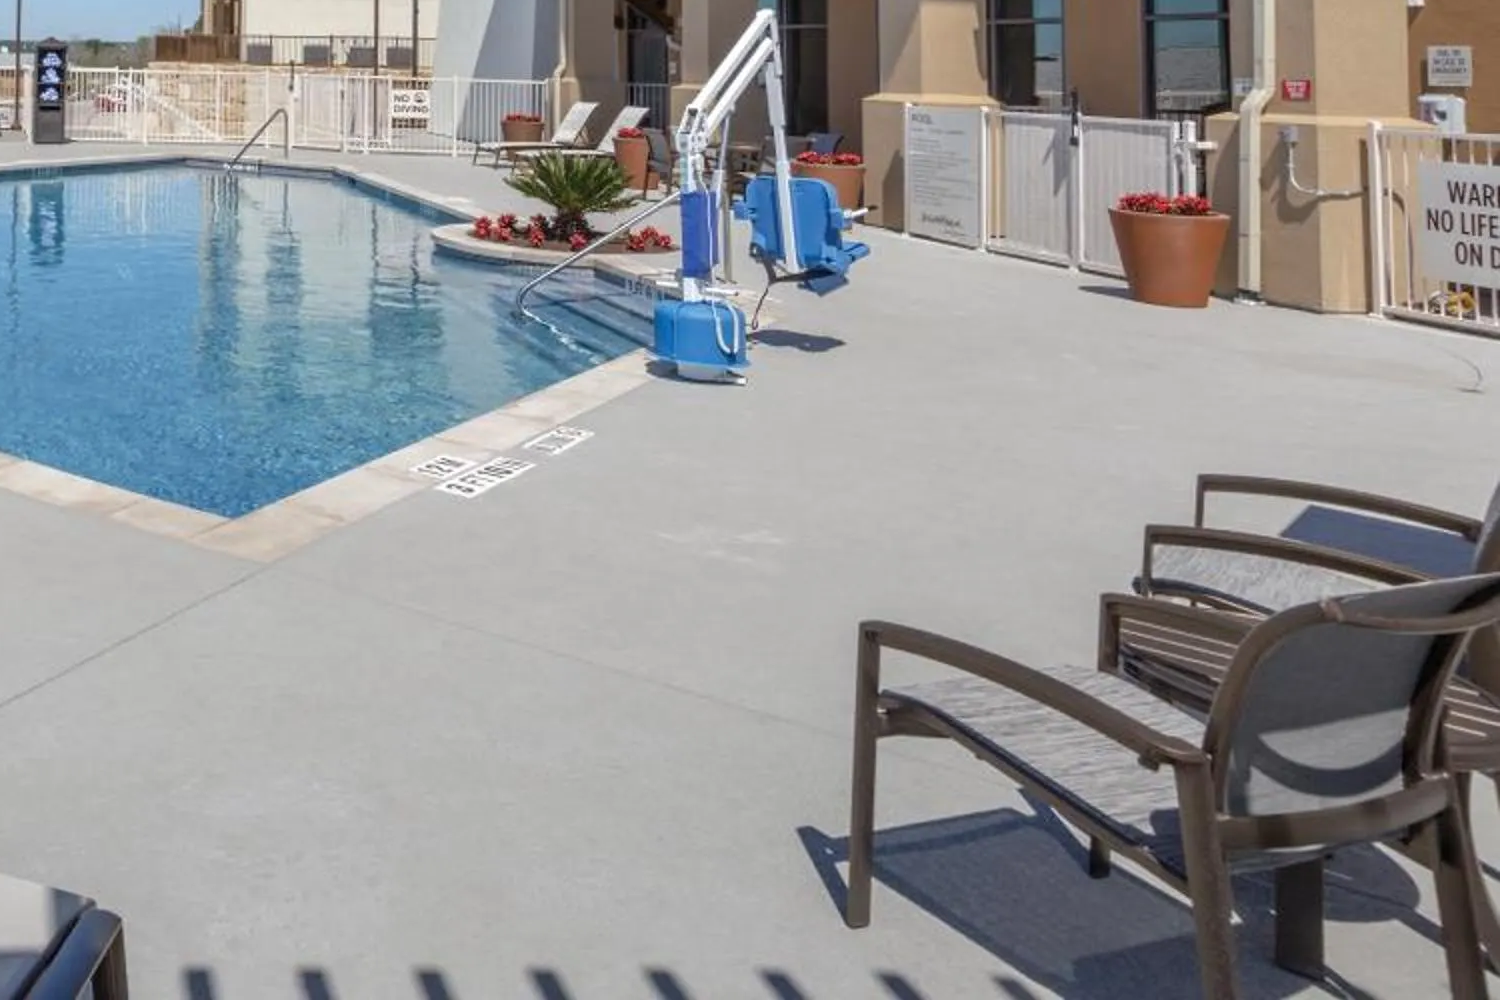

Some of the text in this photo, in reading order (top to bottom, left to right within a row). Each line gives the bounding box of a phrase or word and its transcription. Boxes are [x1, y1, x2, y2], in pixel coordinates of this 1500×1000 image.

[1447, 181, 1500, 208] WAR
[1427, 208, 1454, 233] NO
[1455, 241, 1483, 267] ON
